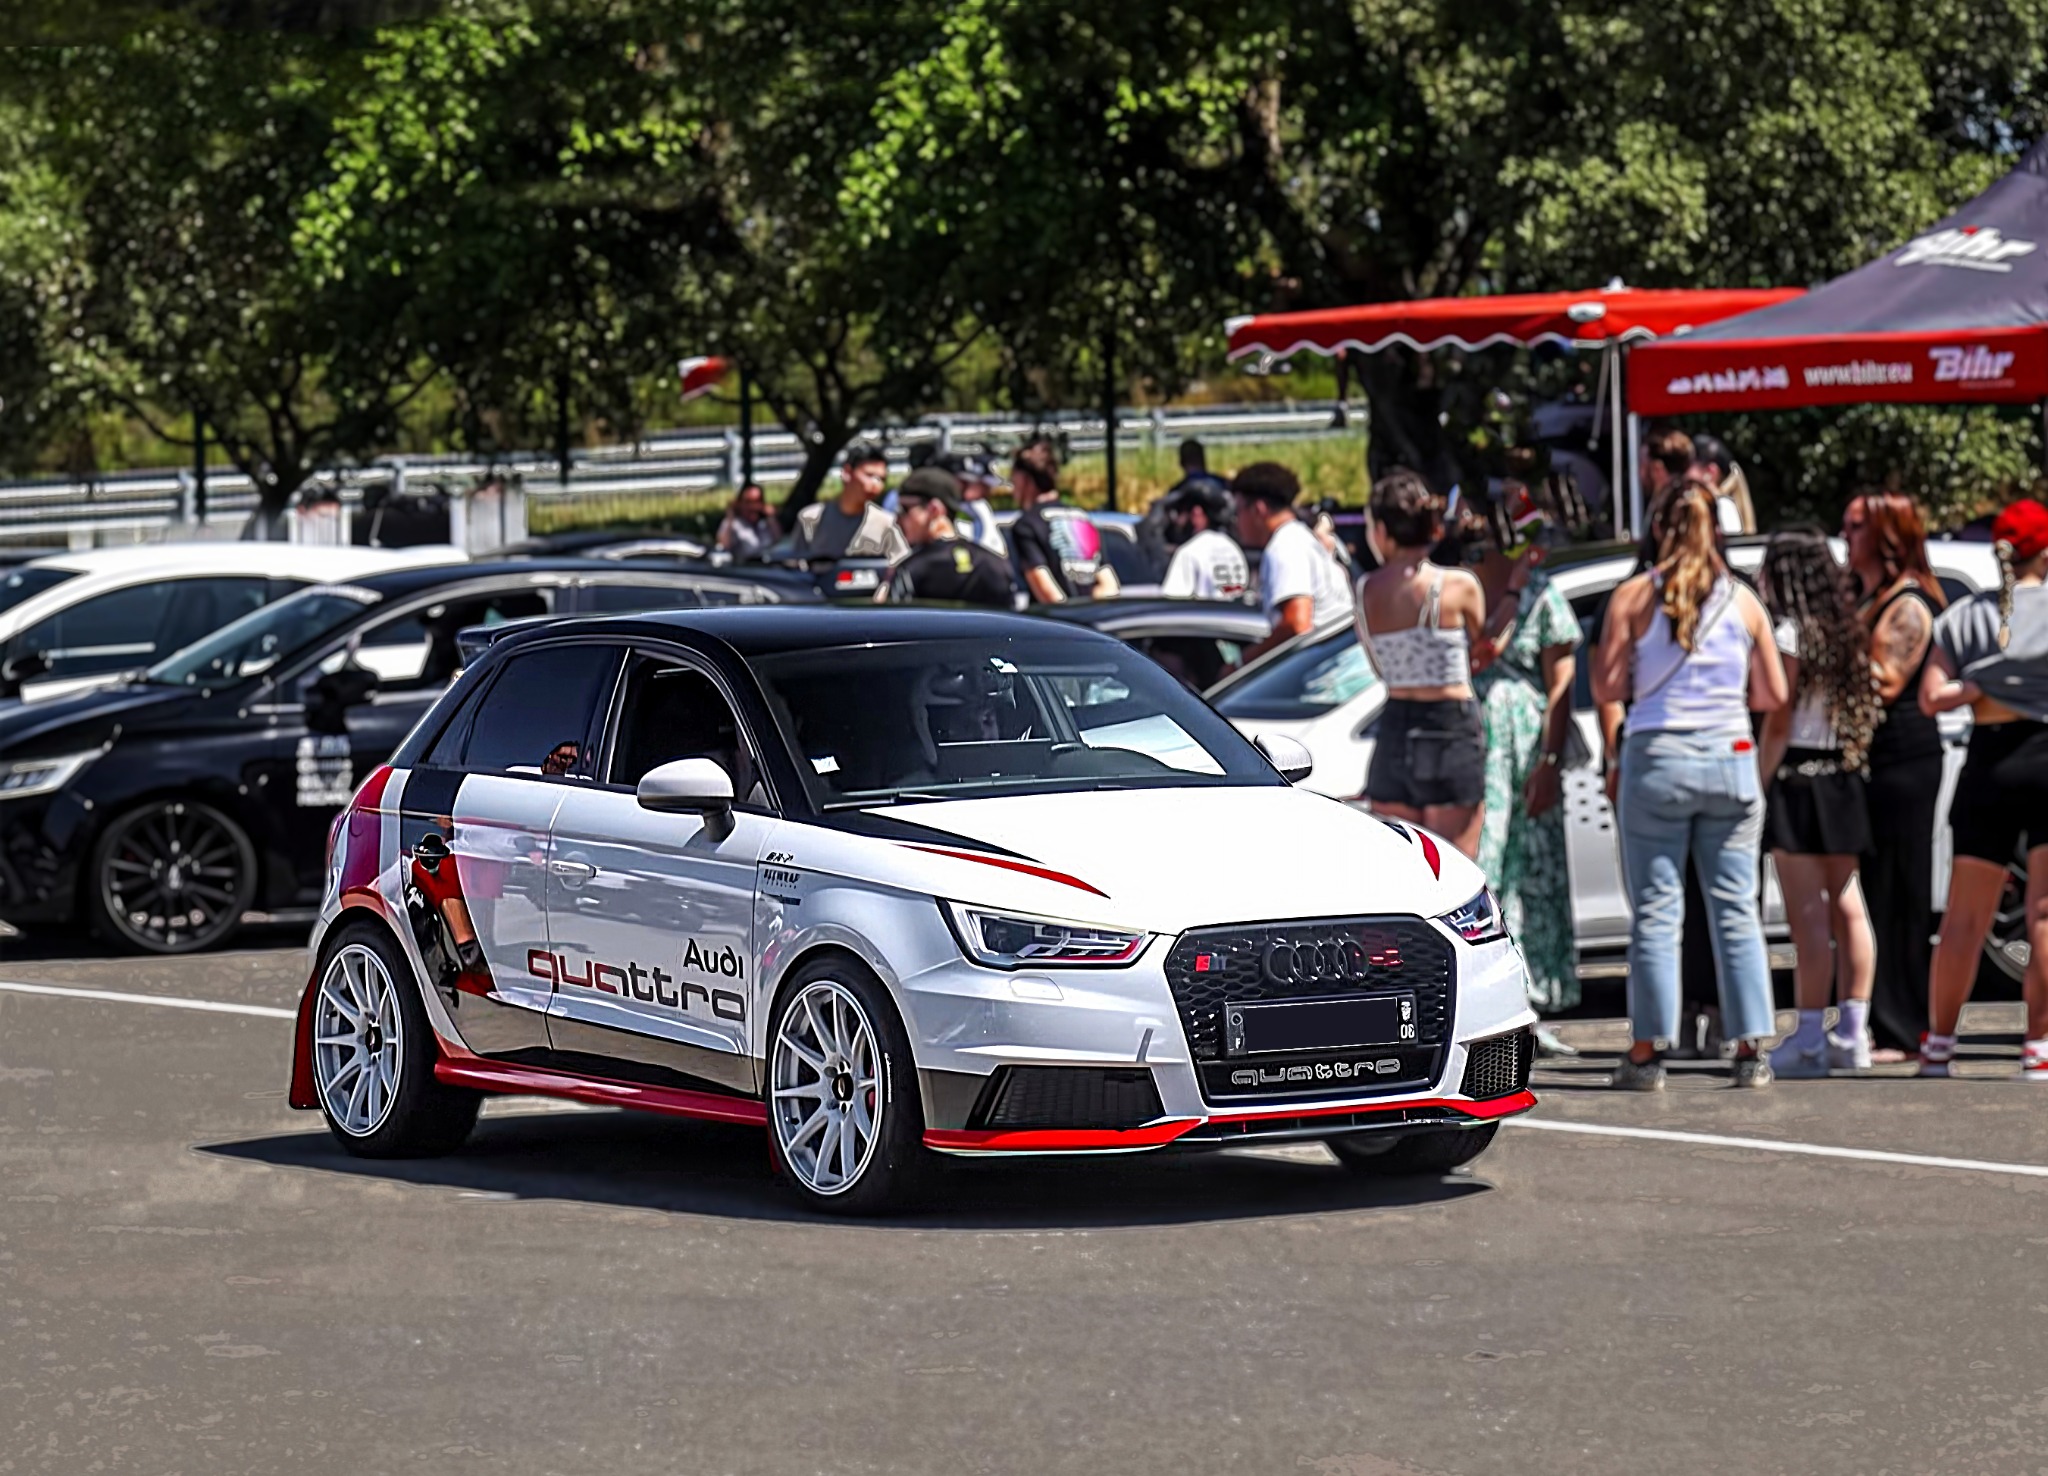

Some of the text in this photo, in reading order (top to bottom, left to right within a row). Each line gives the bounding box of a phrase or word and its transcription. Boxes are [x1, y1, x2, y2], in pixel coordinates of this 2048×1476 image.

[1929, 344, 2015, 382] Bihr
[683, 937, 745, 980] Audi
[527, 948, 746, 1022] quattro
[1231, 1058, 1401, 1086] quattro
